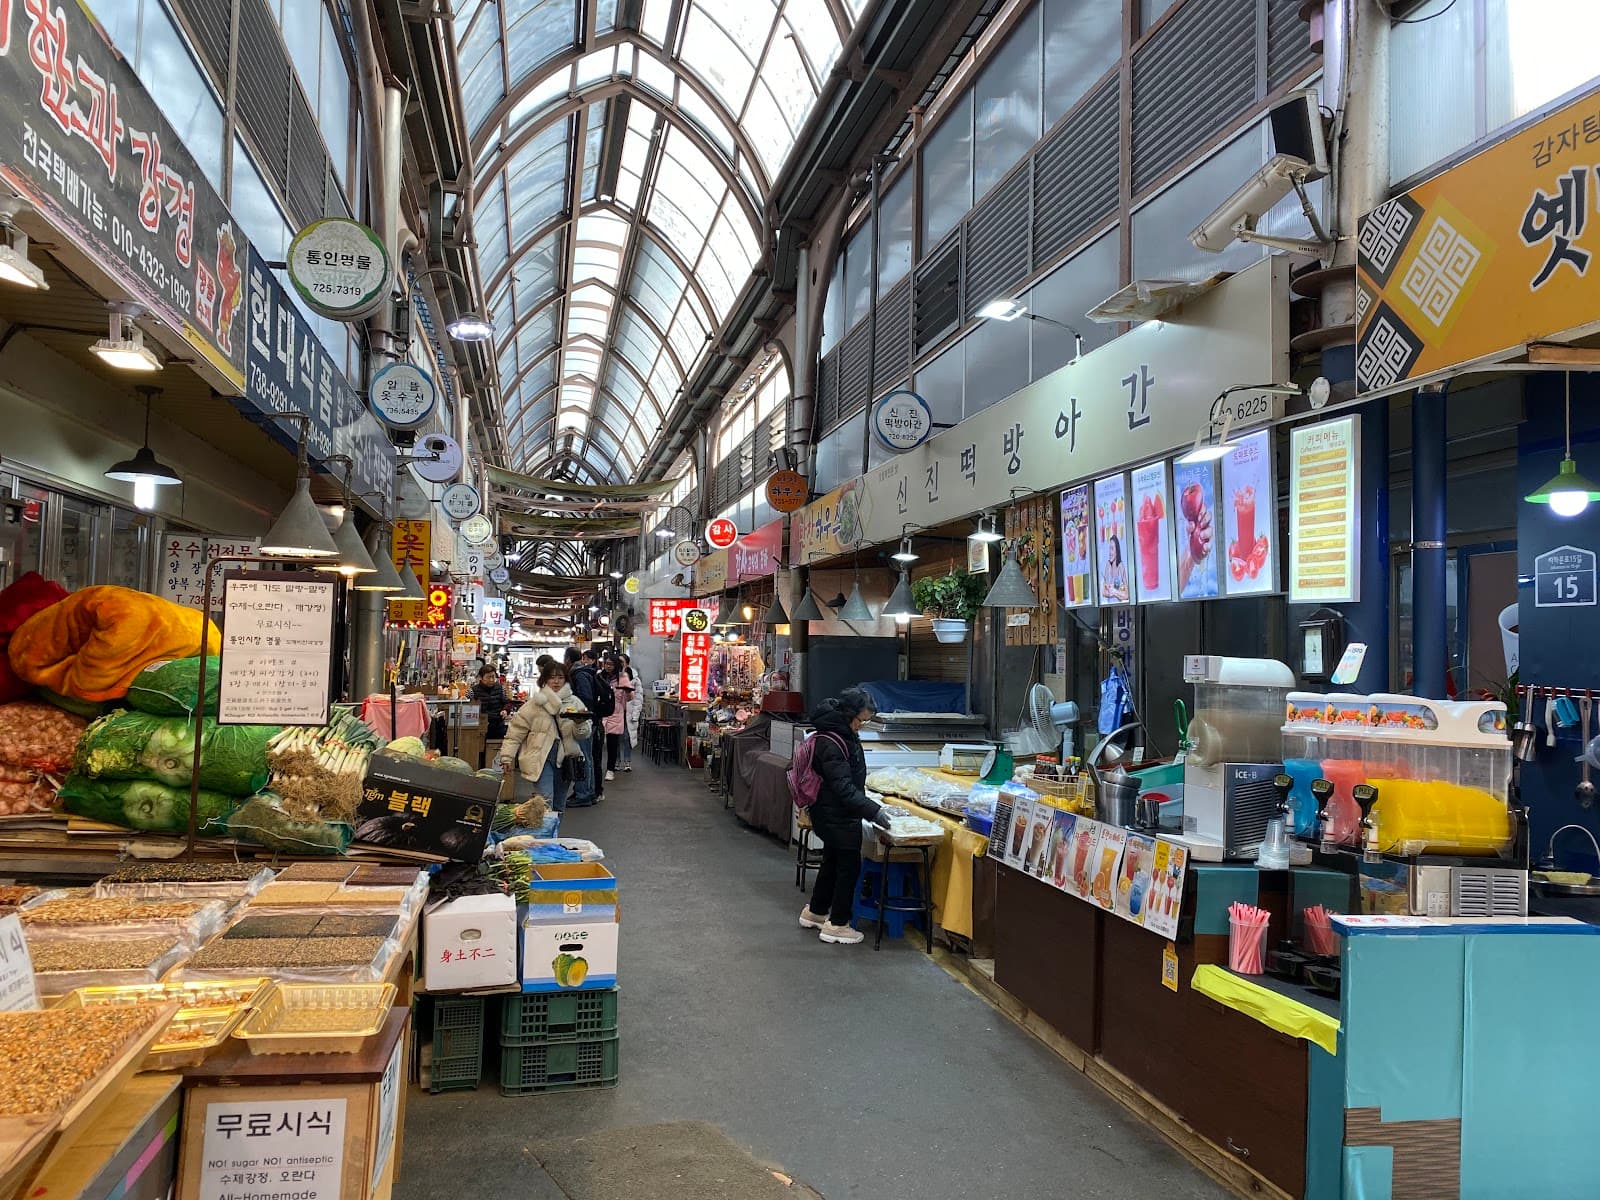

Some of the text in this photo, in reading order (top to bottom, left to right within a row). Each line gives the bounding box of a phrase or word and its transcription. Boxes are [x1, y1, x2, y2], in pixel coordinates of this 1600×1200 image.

[129, 127, 196, 269] 강정
[305, 249, 372, 270] 통인명물
[312, 282, 362, 296] 725.7319
[250, 265, 333, 428] 현대식품
[885, 418, 922, 429] 떡방아간
[1554, 576, 1579, 599] 15
[387, 790, 432, 818] 블랙
[440, 948, 496, 964] 身土不二
[216, 1111, 332, 1139] 무료시식
[232, 1159, 259, 1169] sugar
[280, 1170, 316, 1182] 오란다
